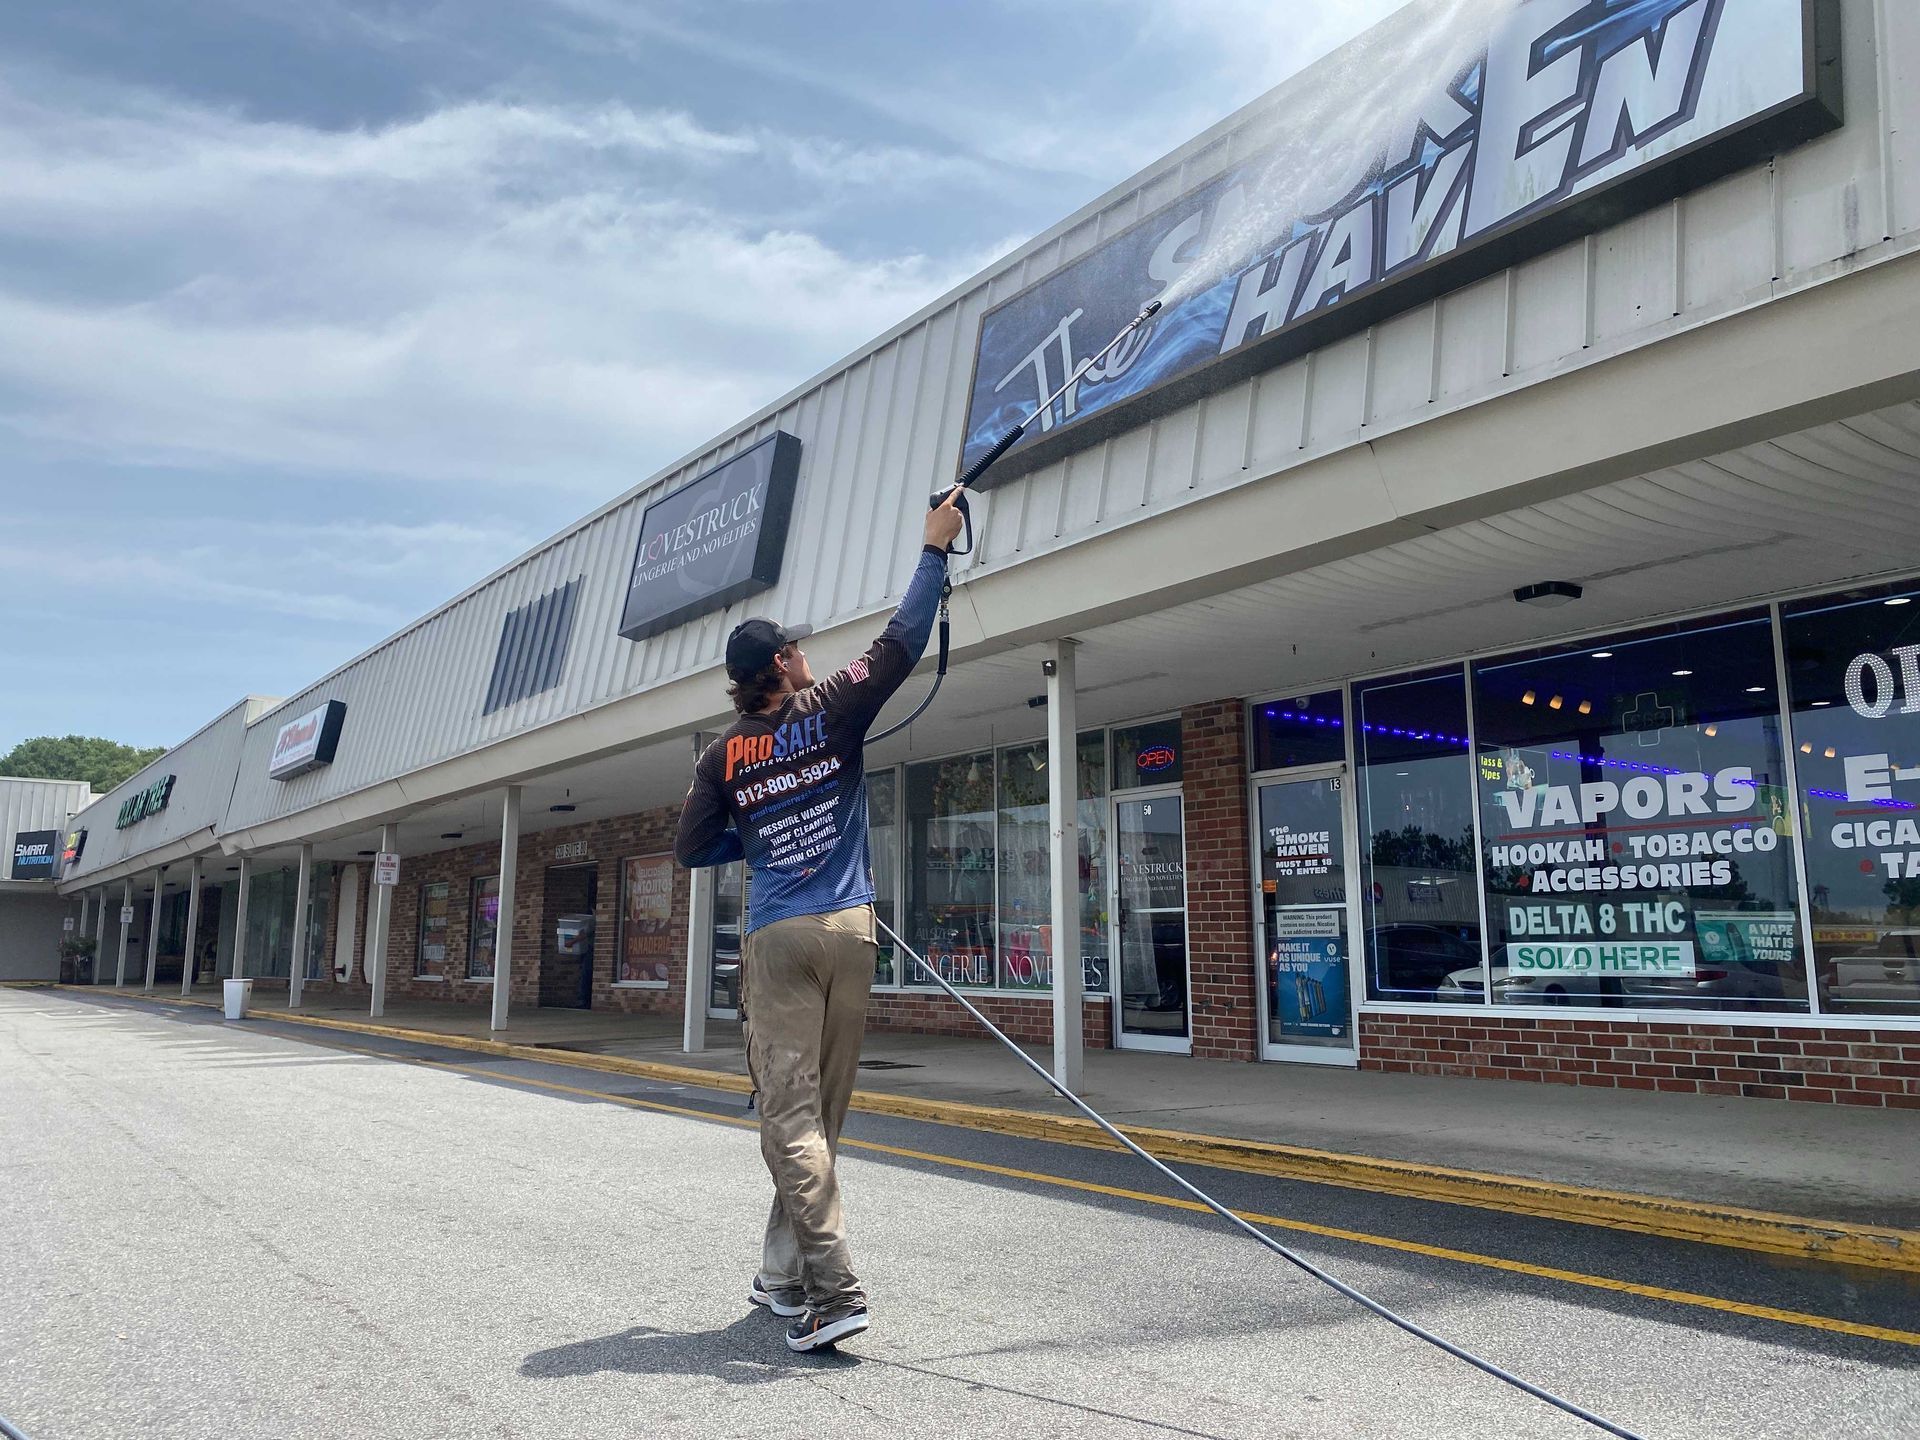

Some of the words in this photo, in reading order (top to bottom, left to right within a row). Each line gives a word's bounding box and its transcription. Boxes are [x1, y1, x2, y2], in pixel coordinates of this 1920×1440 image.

[1216, 0, 1725, 356] HAVEN
[994, 307, 1153, 432] The
[632, 557, 678, 588] LINGERIE
[677, 546, 700, 568] AND
[700, 517, 757, 557] NOVELTIES
[738, 741, 826, 776] POWERWASHING
[1137, 750, 1175, 766] OPEN
[1497, 758, 1503, 768] &
[735, 756, 841, 807] 912-800-5924
[1330, 778, 1341, 791] 13
[1503, 766, 1756, 829] VAPORS
[1143, 805, 1152, 815] 50
[758, 813, 801, 838] PRESSURE
[793, 812, 834, 837] CLEANING
[1269, 825, 1290, 836] The
[799, 823, 837, 847] WASHING
[1275, 831, 1330, 846] SMOKE
[15, 844, 48, 857] SMART
[1277, 843, 1329, 857] HAVEN
[1492, 839, 1605, 867] HOOKAH
[1628, 827, 1777, 859] TOBACCO
[1276, 860, 1301, 869] MUST
[1305, 859, 1318, 867] BE
[1322, 858, 1332, 866] 18
[1296, 867, 1328, 875] ENTER
[1532, 861, 1732, 893] ACCESSORIES
[1509, 904, 1595, 935] DELTA
[1599, 903, 1617, 934] 8
[1622, 901, 1687, 933] THC
[1749, 924, 1759, 935] A
[1759, 924, 1793, 935] VAPE
[1278, 942, 1301, 952] MAKE
[1302, 942, 1310, 952] IT
[1749, 936, 1781, 948] THAT
[1782, 937, 1794, 949] IS
[1279, 953, 1290, 962] AS
[1291, 953, 1321, 963] UNIQUE
[1518, 946, 1592, 971] SOLD
[1600, 946, 1682, 971] HERE
[1752, 949, 1792, 961] YOURS
[913, 954, 988, 984] LINGERIE
[1005, 955, 1102, 987] NOVEES
[1280, 963, 1290, 972] AS
[1291, 963, 1308, 972] YOU
